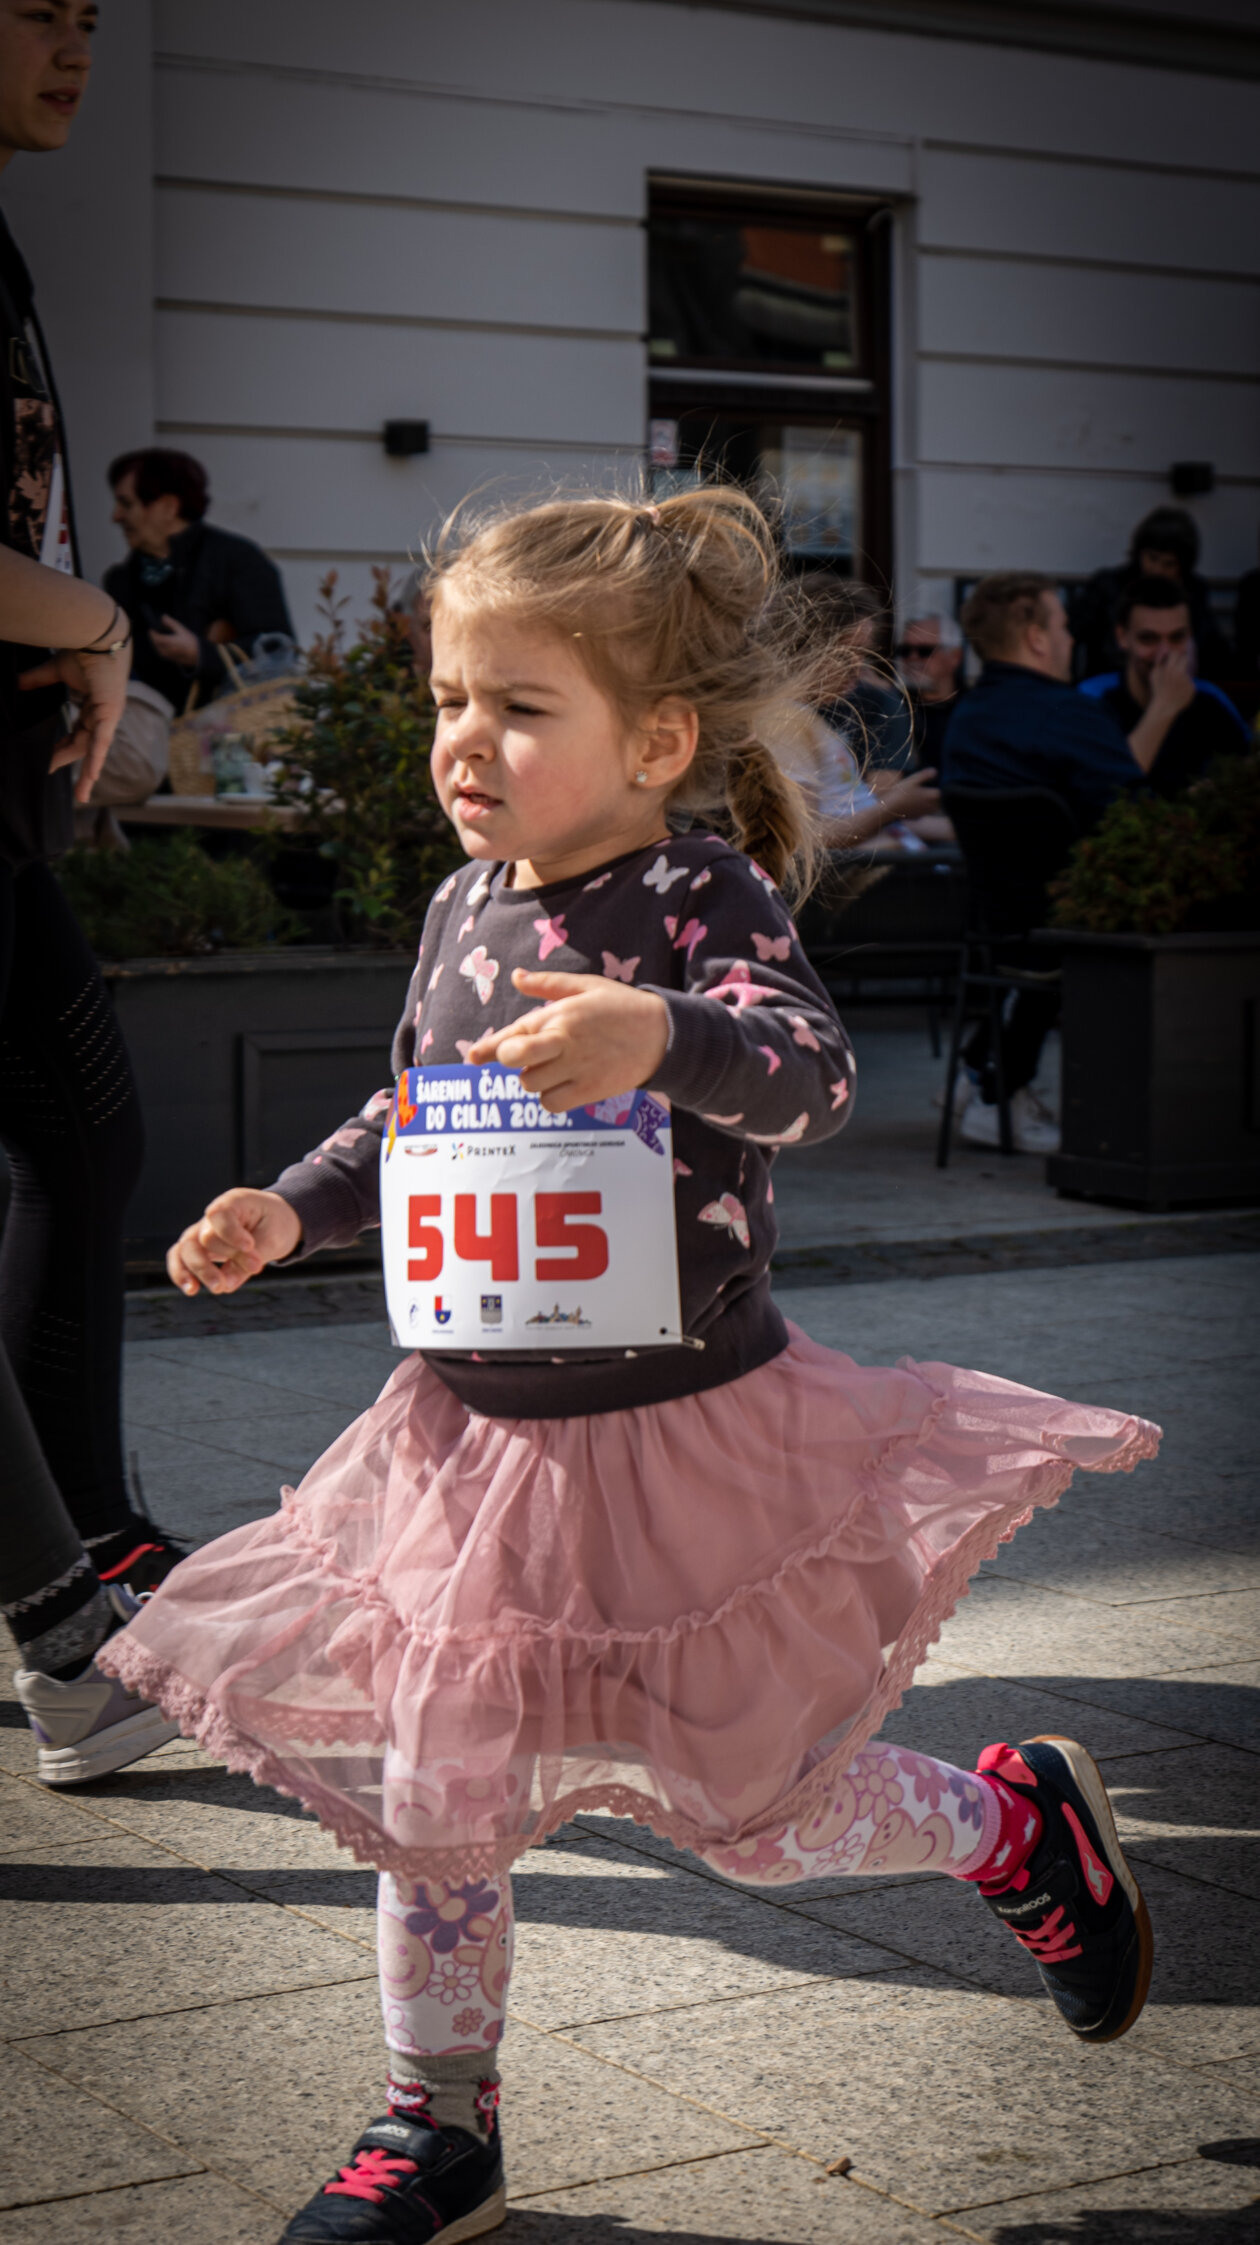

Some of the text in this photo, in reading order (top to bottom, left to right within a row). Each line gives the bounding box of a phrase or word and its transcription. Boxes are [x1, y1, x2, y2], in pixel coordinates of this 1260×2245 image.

[416, 1075, 472, 1103] ŠARENIM
[426, 1104, 446, 1130] DO
[451, 1103, 502, 1130] CILJA
[407, 1191, 609, 1282] 545
